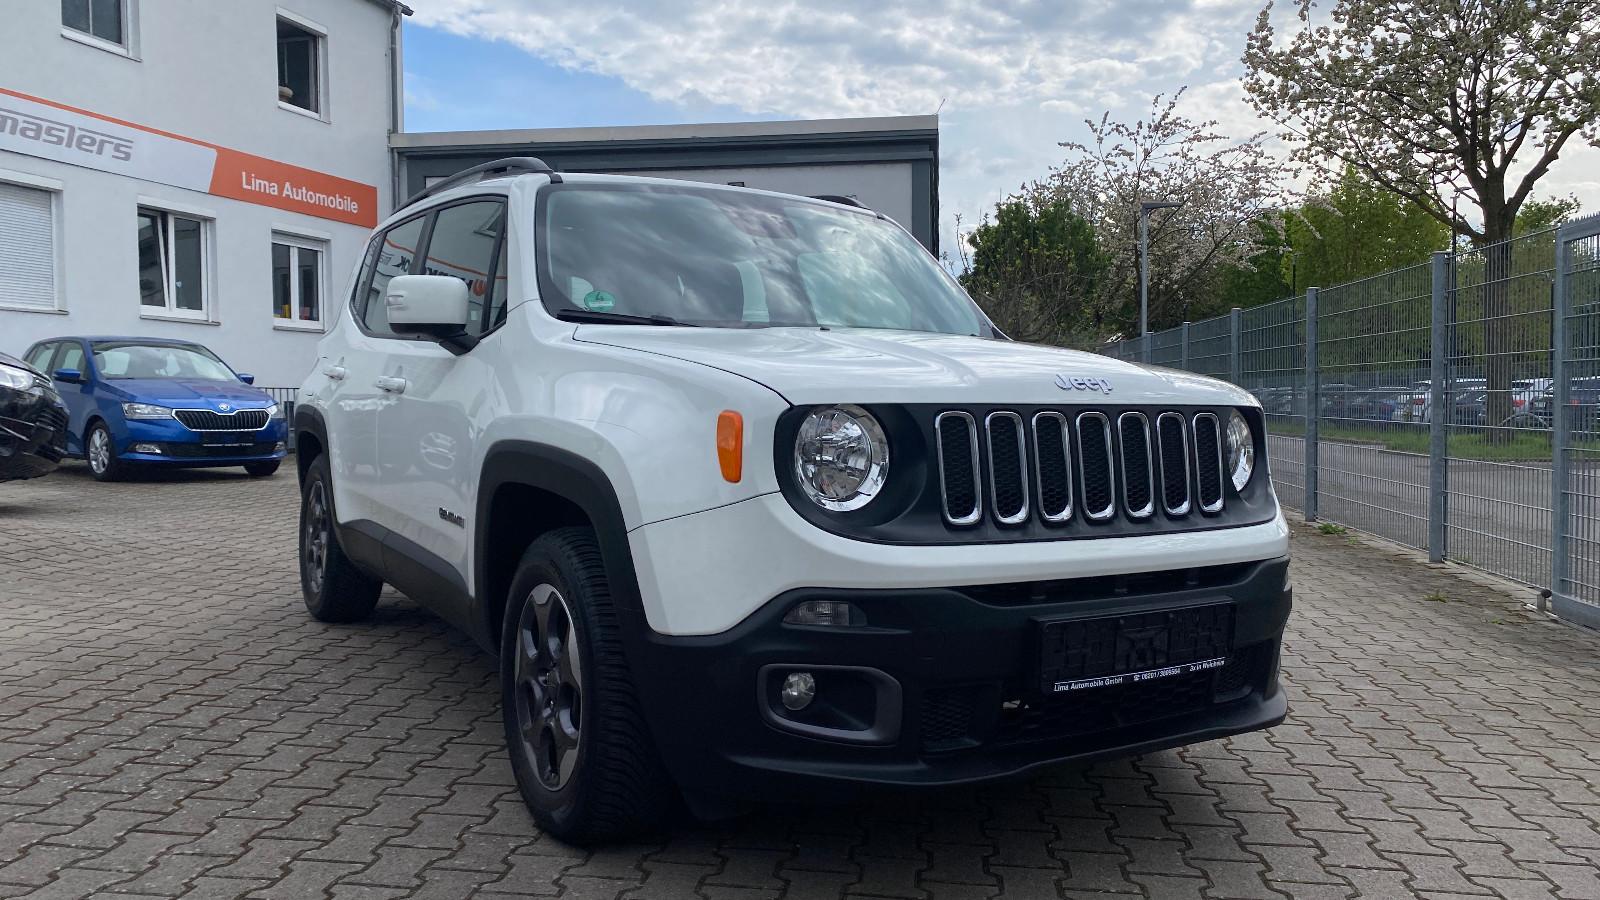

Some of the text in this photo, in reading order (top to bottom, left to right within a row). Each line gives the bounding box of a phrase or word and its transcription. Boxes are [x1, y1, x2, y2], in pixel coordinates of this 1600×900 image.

[241, 171, 359, 214] Lima Automobile
[1054, 374, 1113, 396] Jeep
[1053, 684, 1069, 692] Lima
[1070, 680, 1104, 690] Automobile
[1104, 676, 1123, 686] GmbH
